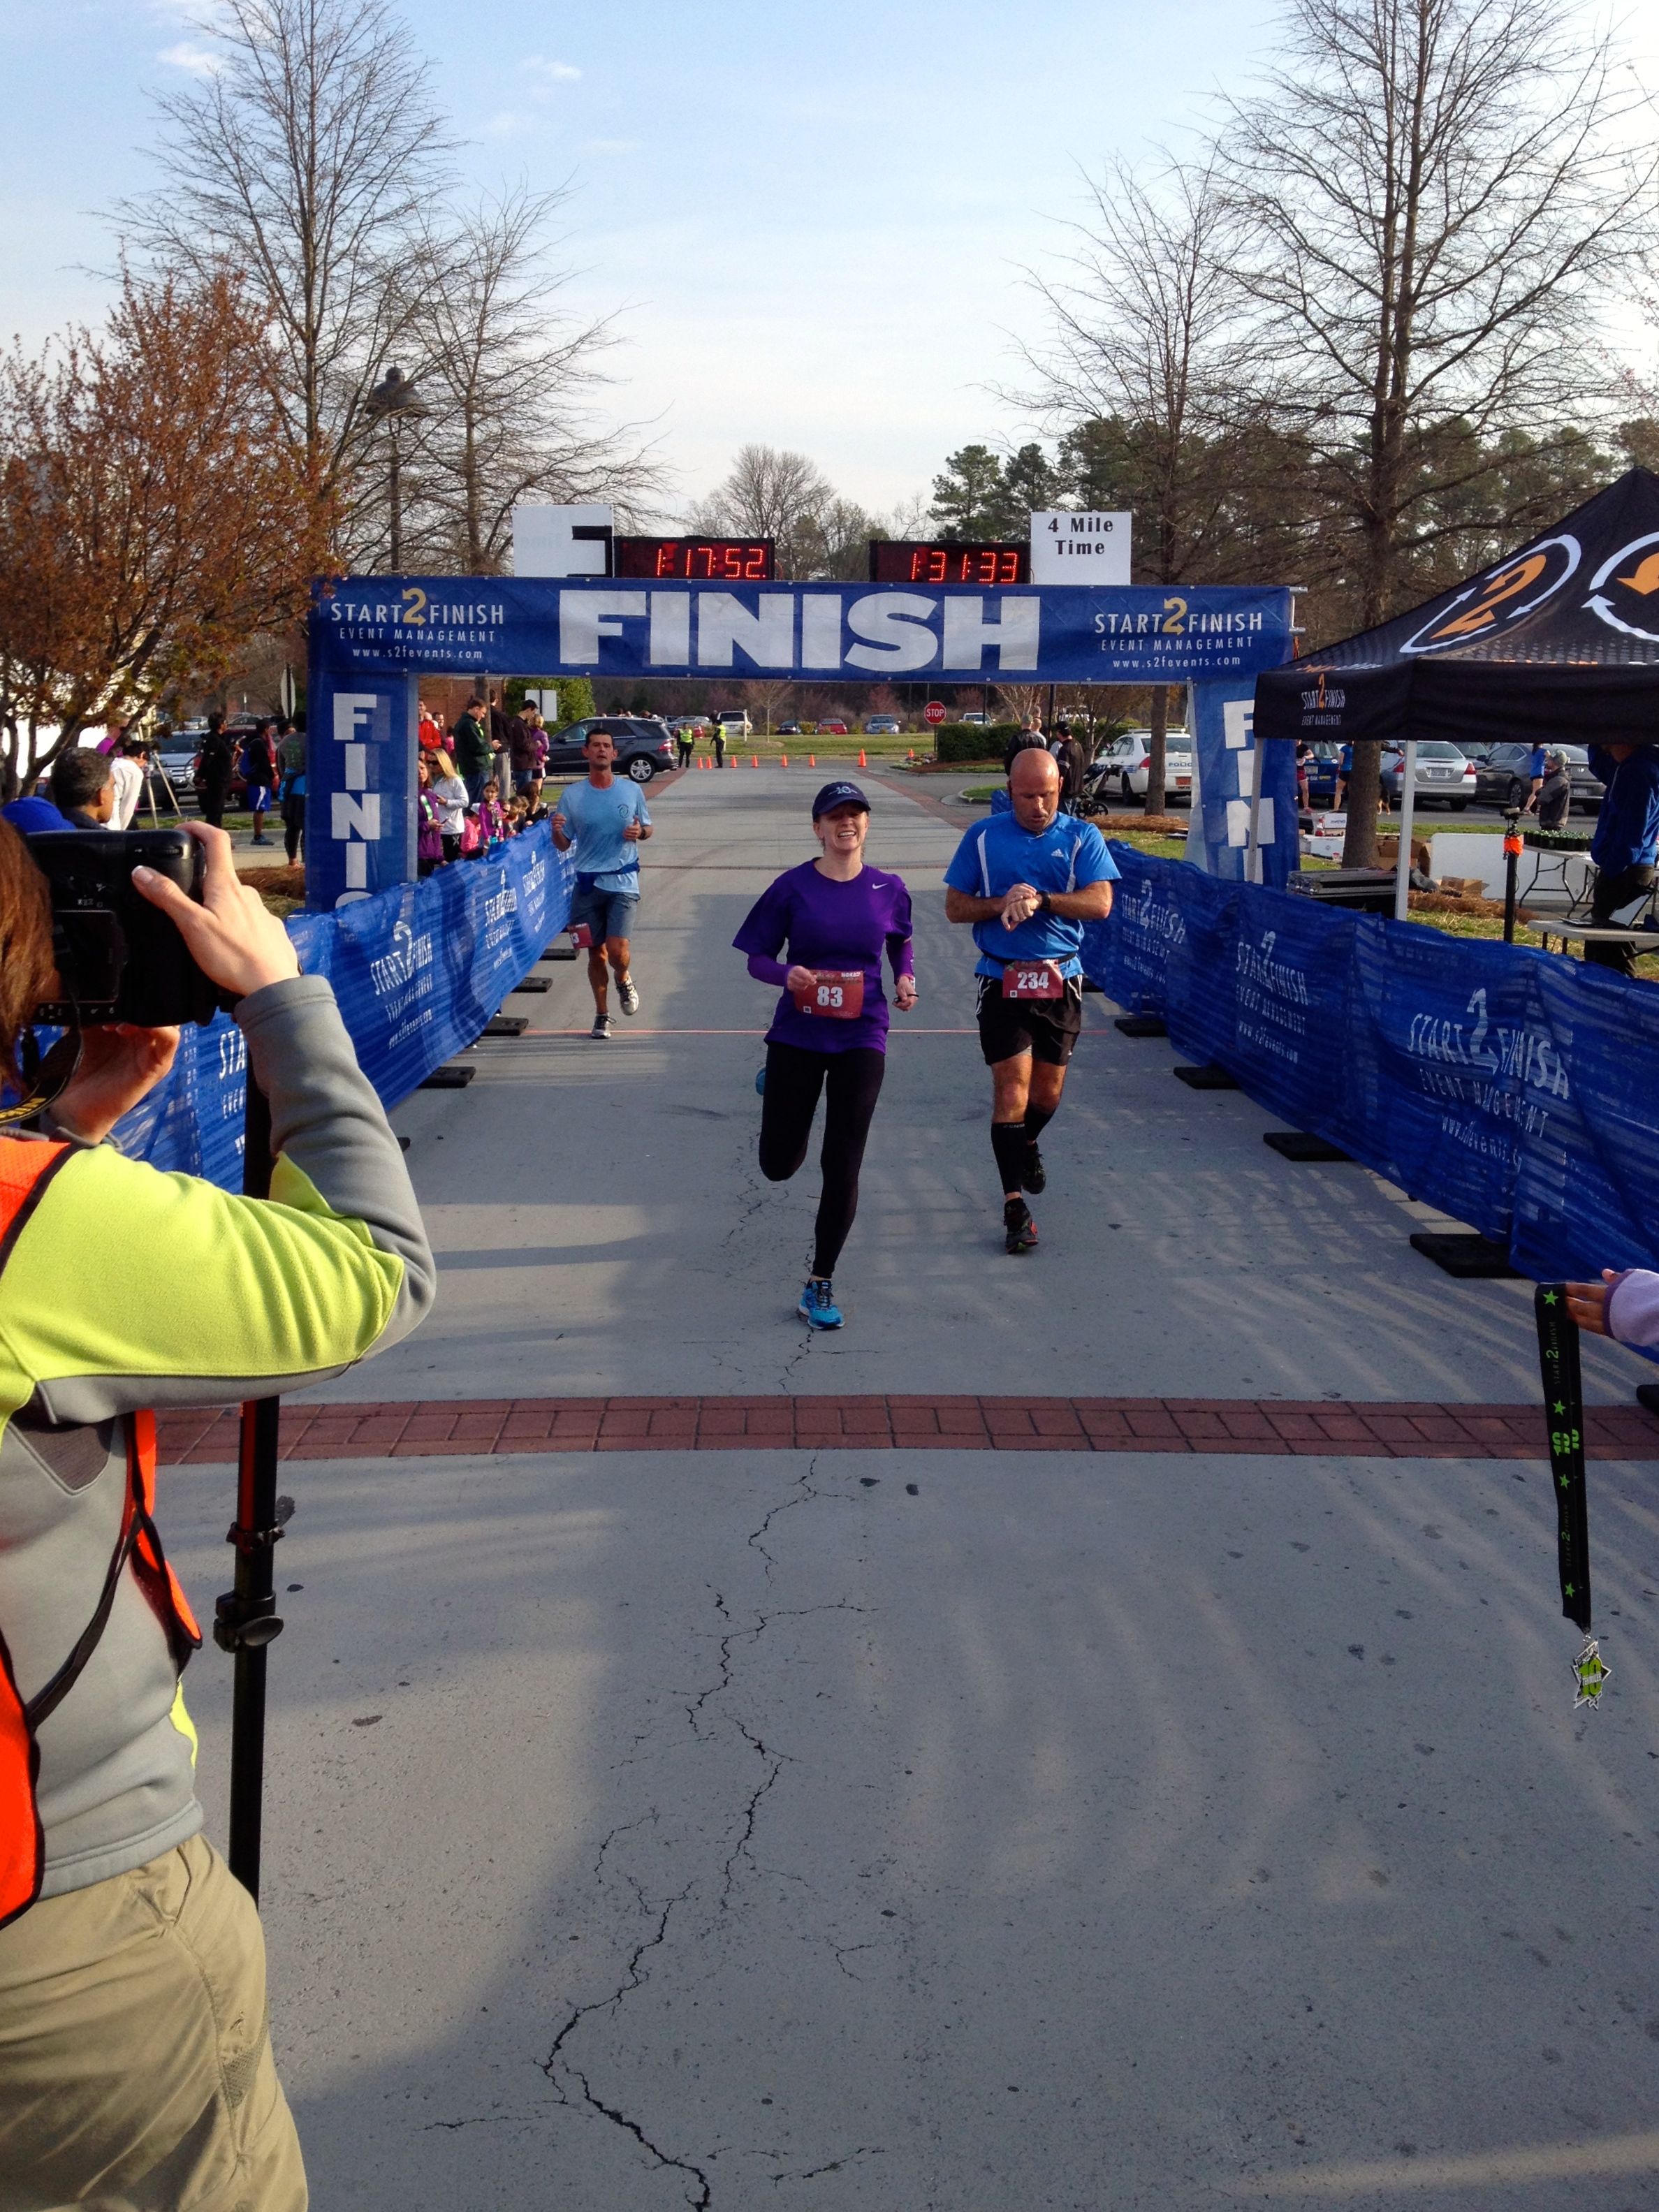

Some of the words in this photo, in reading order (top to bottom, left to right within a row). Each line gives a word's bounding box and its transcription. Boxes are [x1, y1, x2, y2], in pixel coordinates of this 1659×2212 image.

[1048, 518, 1059, 533] 4
[1071, 517, 1114, 533] Mile
[1055, 539, 1106, 555] Time
[339, 627, 383, 640] EVENT
[394, 629, 495, 643] MANAGEMENT
[560, 589, 1041, 672] FINISH
[352, 645, 483, 659] www.s2fevents.com
[1101, 639, 1144, 652] EVENT
[1153, 636, 1254, 651] MANAGEMENT
[1112, 655, 1241, 668] www.s2fevents.com
[926, 708, 944, 717] STOP
[1017, 971, 1049, 990] 234
[817, 986, 843, 1008] 83
